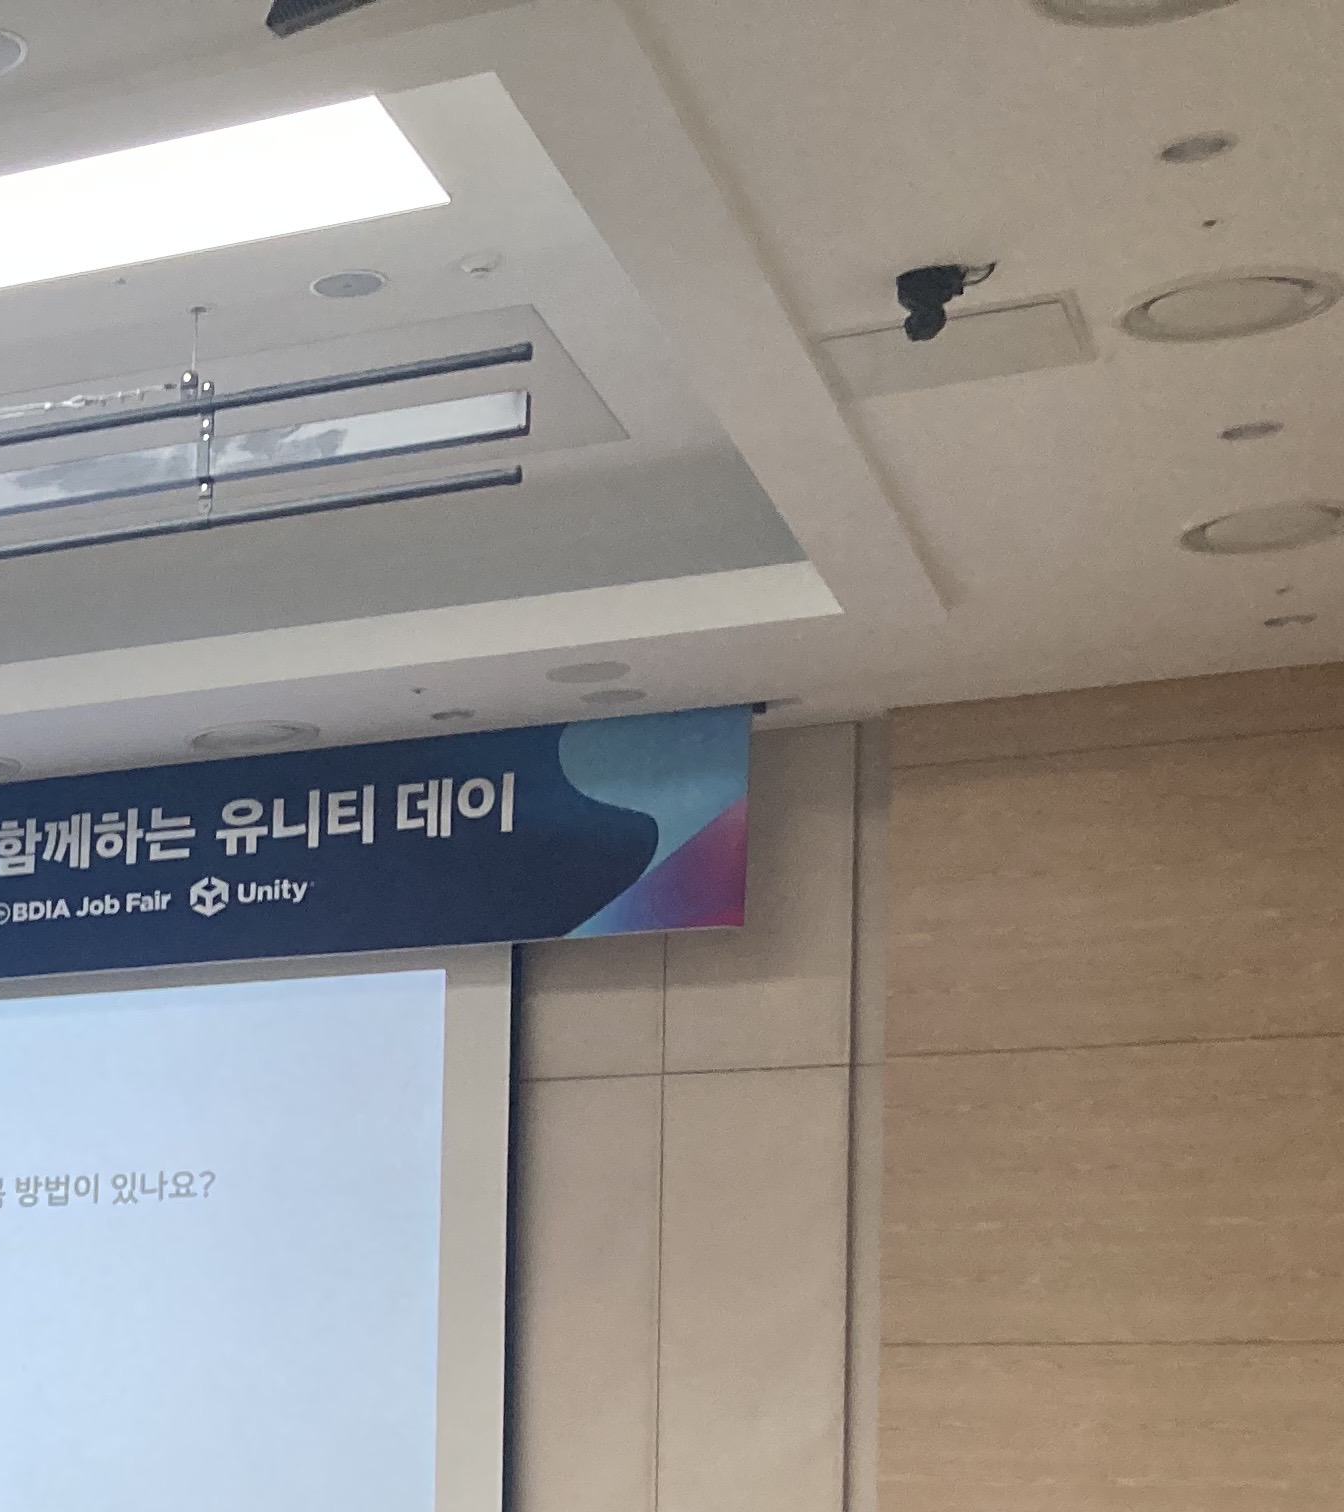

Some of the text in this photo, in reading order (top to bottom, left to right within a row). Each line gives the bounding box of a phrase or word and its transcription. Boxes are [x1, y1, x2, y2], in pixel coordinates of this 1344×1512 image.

[215, 784, 375, 856] 유니티
[396, 771, 515, 838] 데이
[12, 890, 172, 923] BDIA Job Fair
[237, 879, 309, 904] Unity
[15, 1173, 99, 1208] 방법이
[111, 1170, 216, 1205] 있나요?
